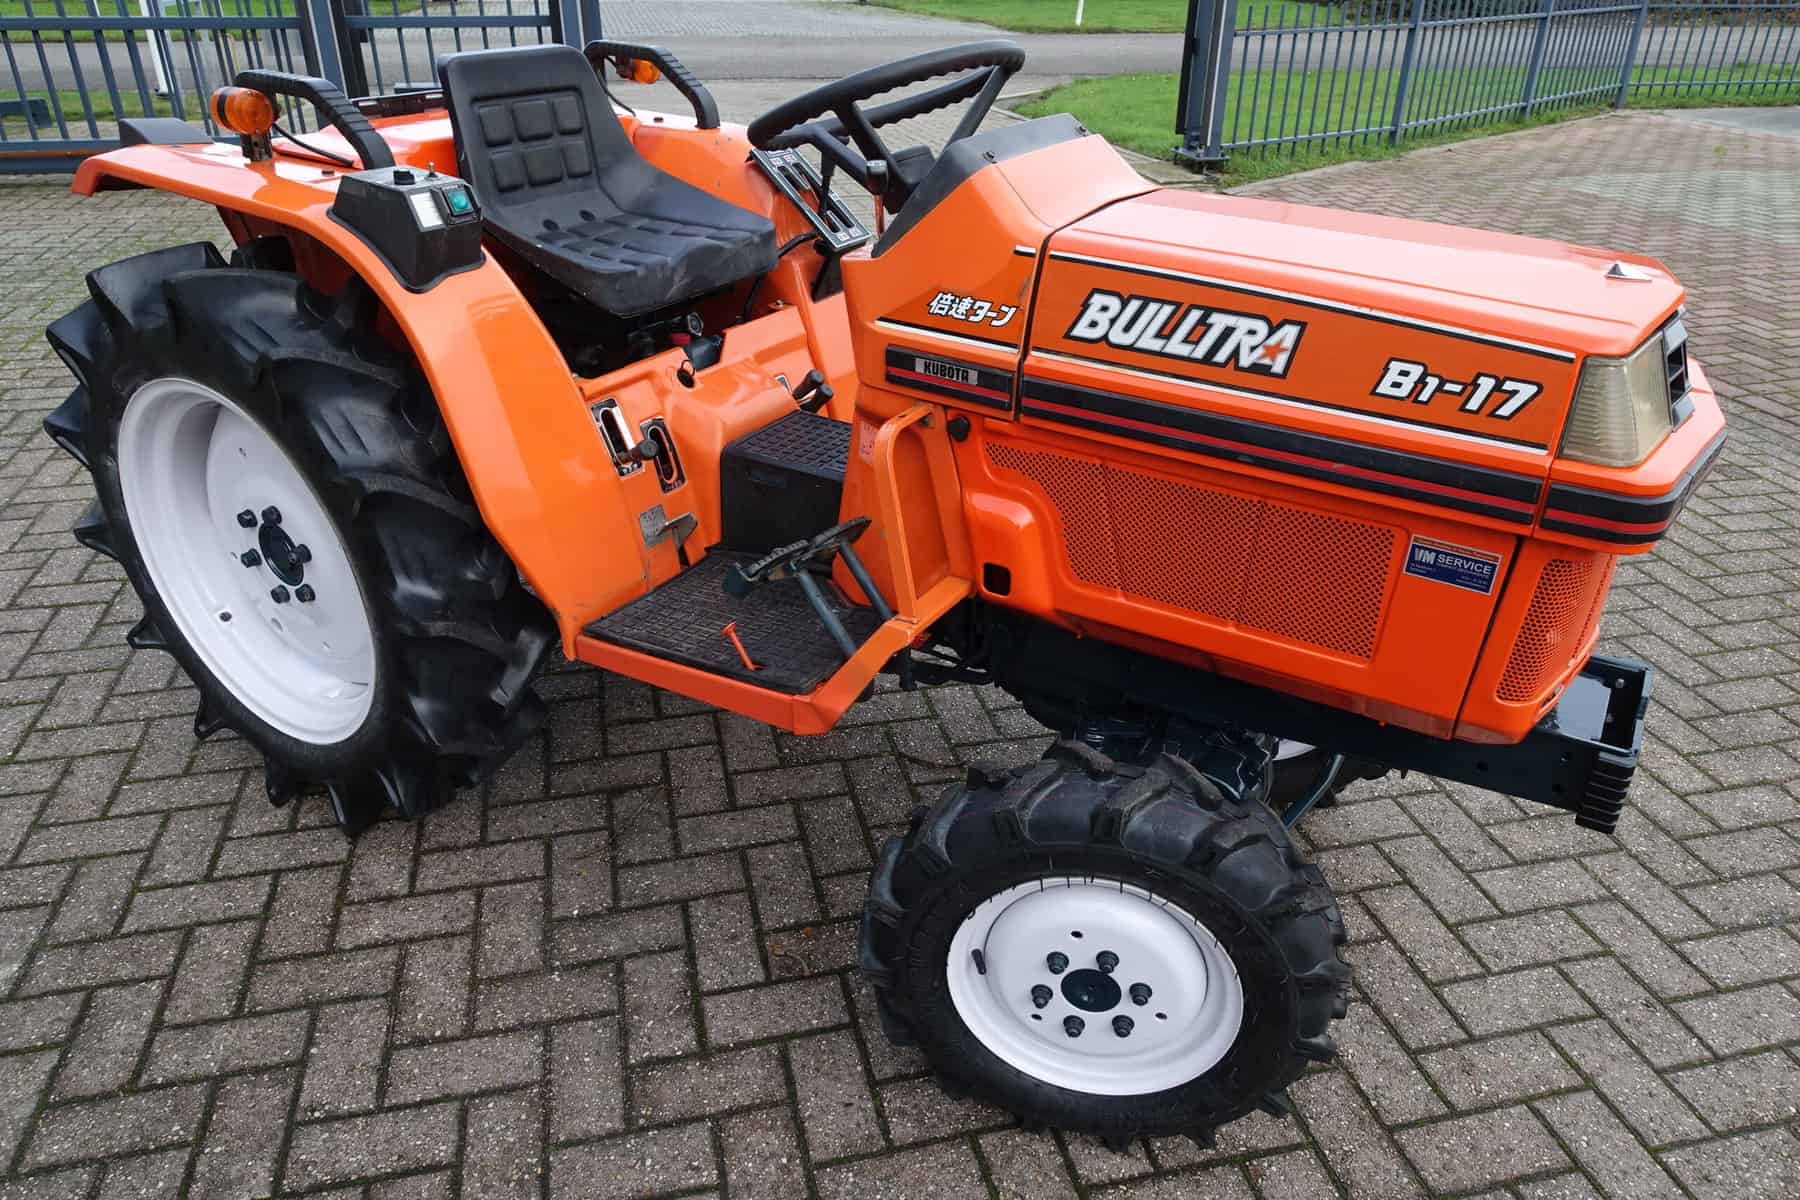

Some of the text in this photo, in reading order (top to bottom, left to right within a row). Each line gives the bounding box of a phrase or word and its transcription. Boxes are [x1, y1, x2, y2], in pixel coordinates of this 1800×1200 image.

[928, 291, 1018, 327] 倍速ターン
[1066, 290, 1305, 377] BULLTRA
[923, 360, 969, 382] KUBOTA
[1372, 358, 1542, 419] B1-17
[1437, 553, 1493, 575] SERVICE
